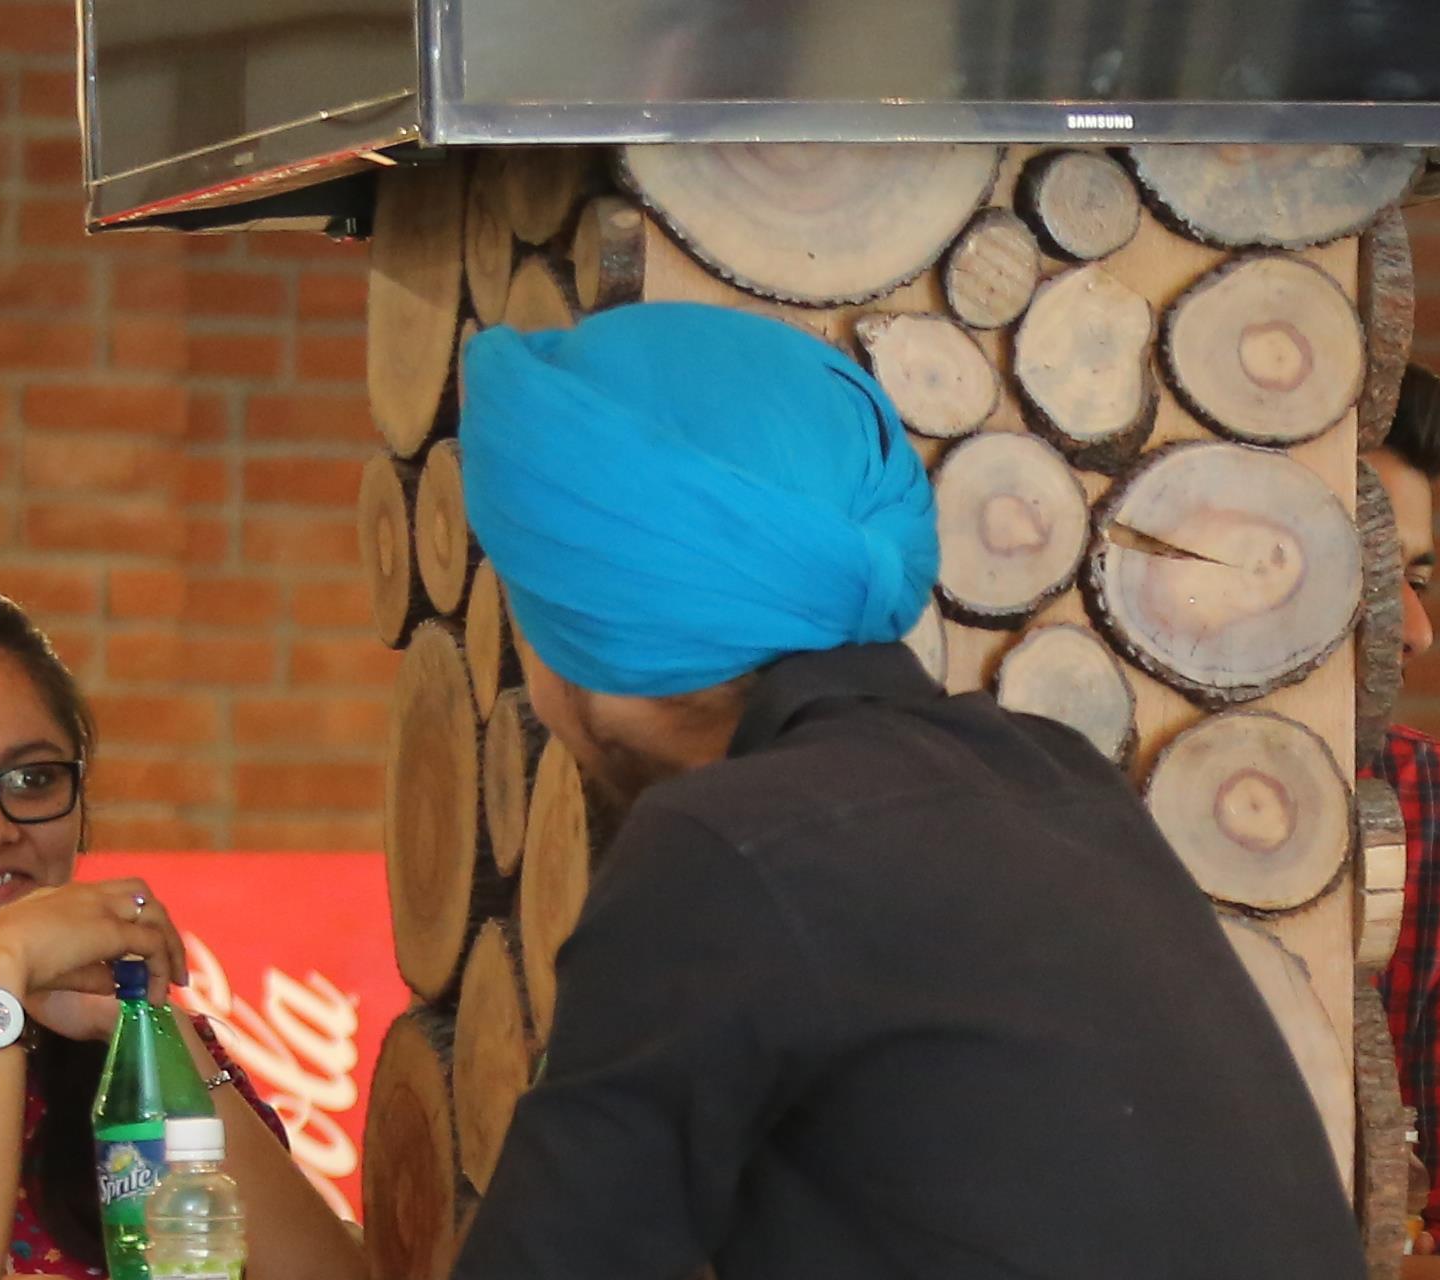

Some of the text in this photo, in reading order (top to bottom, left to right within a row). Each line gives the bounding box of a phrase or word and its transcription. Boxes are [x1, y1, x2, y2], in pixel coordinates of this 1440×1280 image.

[1066, 113, 1134, 130] SAMSUNG
[172, 932, 360, 1226] ola
[98, 1167, 154, 1206] Sprite
